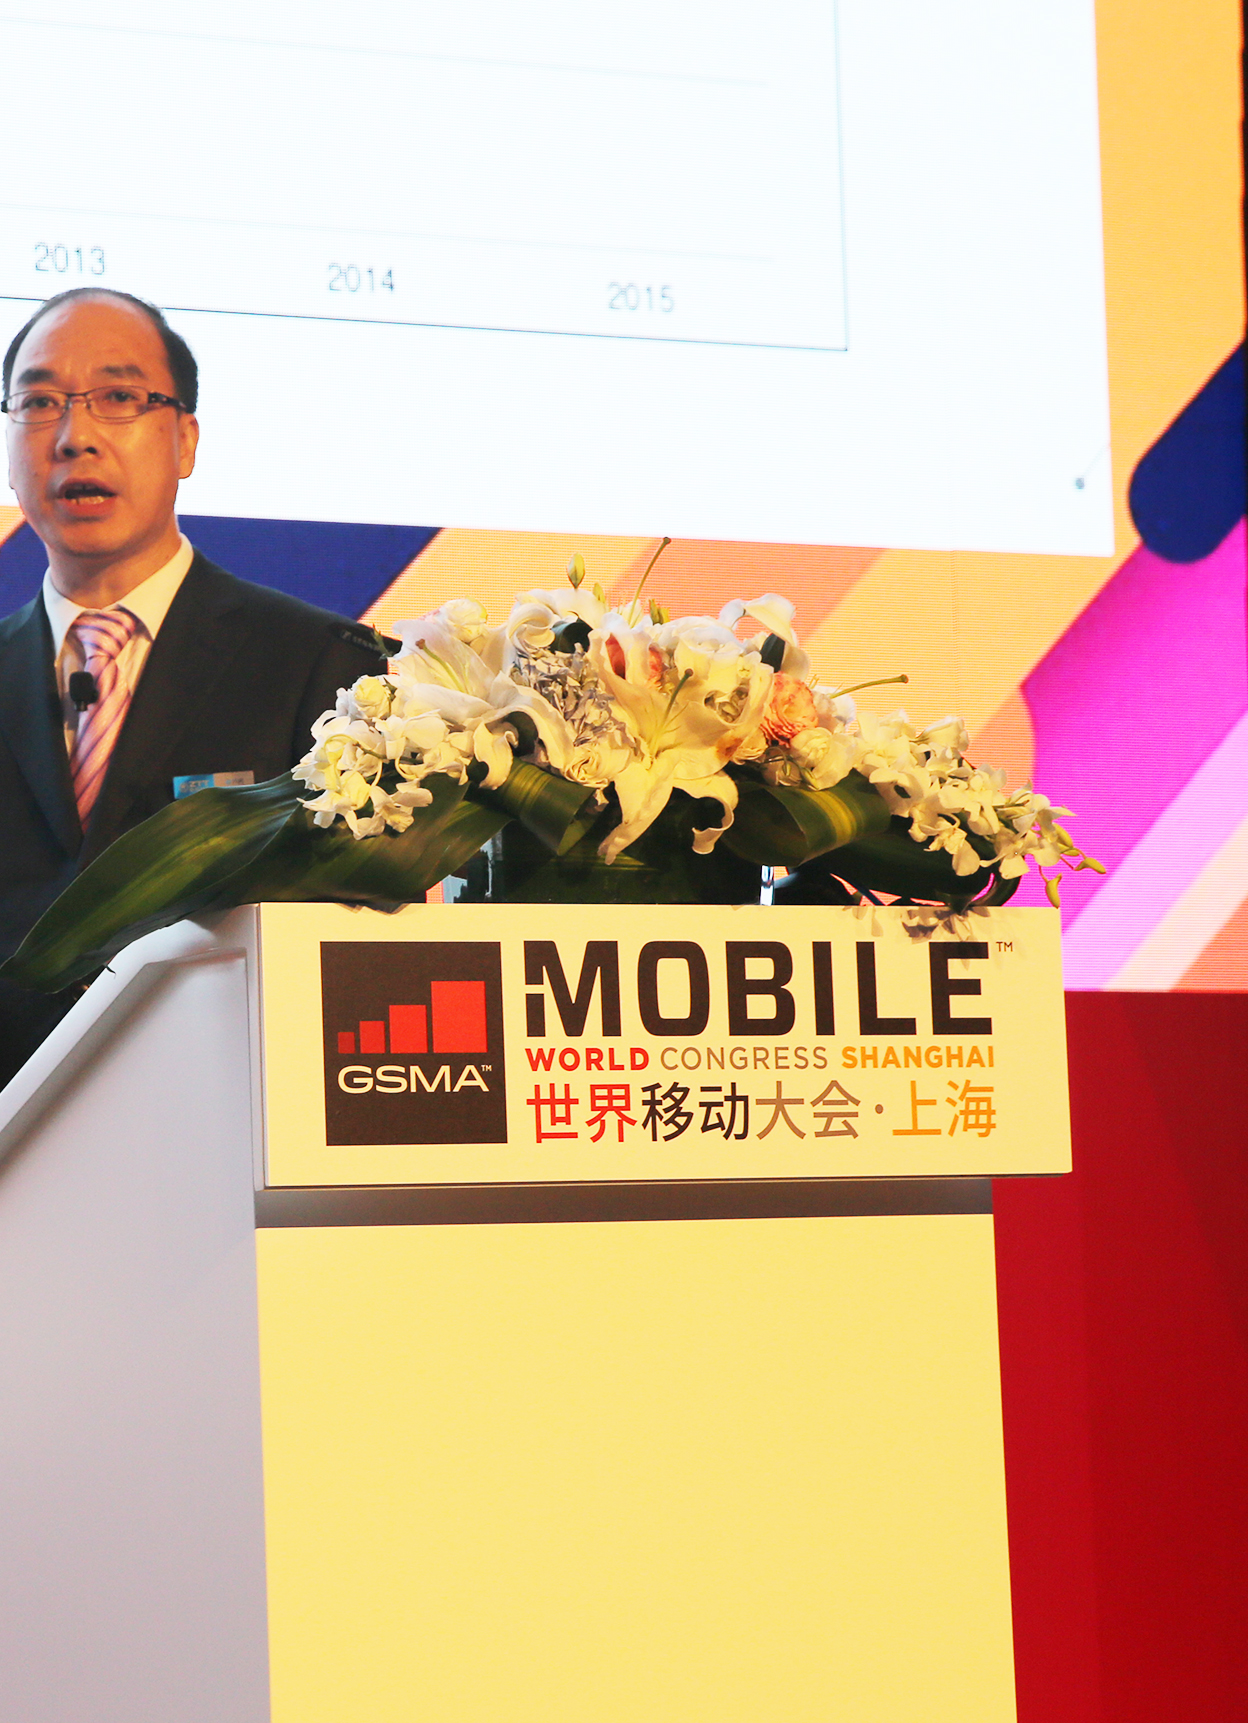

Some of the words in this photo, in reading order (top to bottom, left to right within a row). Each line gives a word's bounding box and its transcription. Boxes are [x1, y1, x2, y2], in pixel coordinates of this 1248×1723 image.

[34, 242, 108, 278] 2013
[327, 263, 397, 297] 2014
[608, 283, 676, 316] 2015
[524, 939, 993, 1038] MOBILE
[525, 1048, 650, 1073] WORLD
[660, 1047, 829, 1072] CONGRESS
[842, 1045, 995, 1069] SHANGHAI
